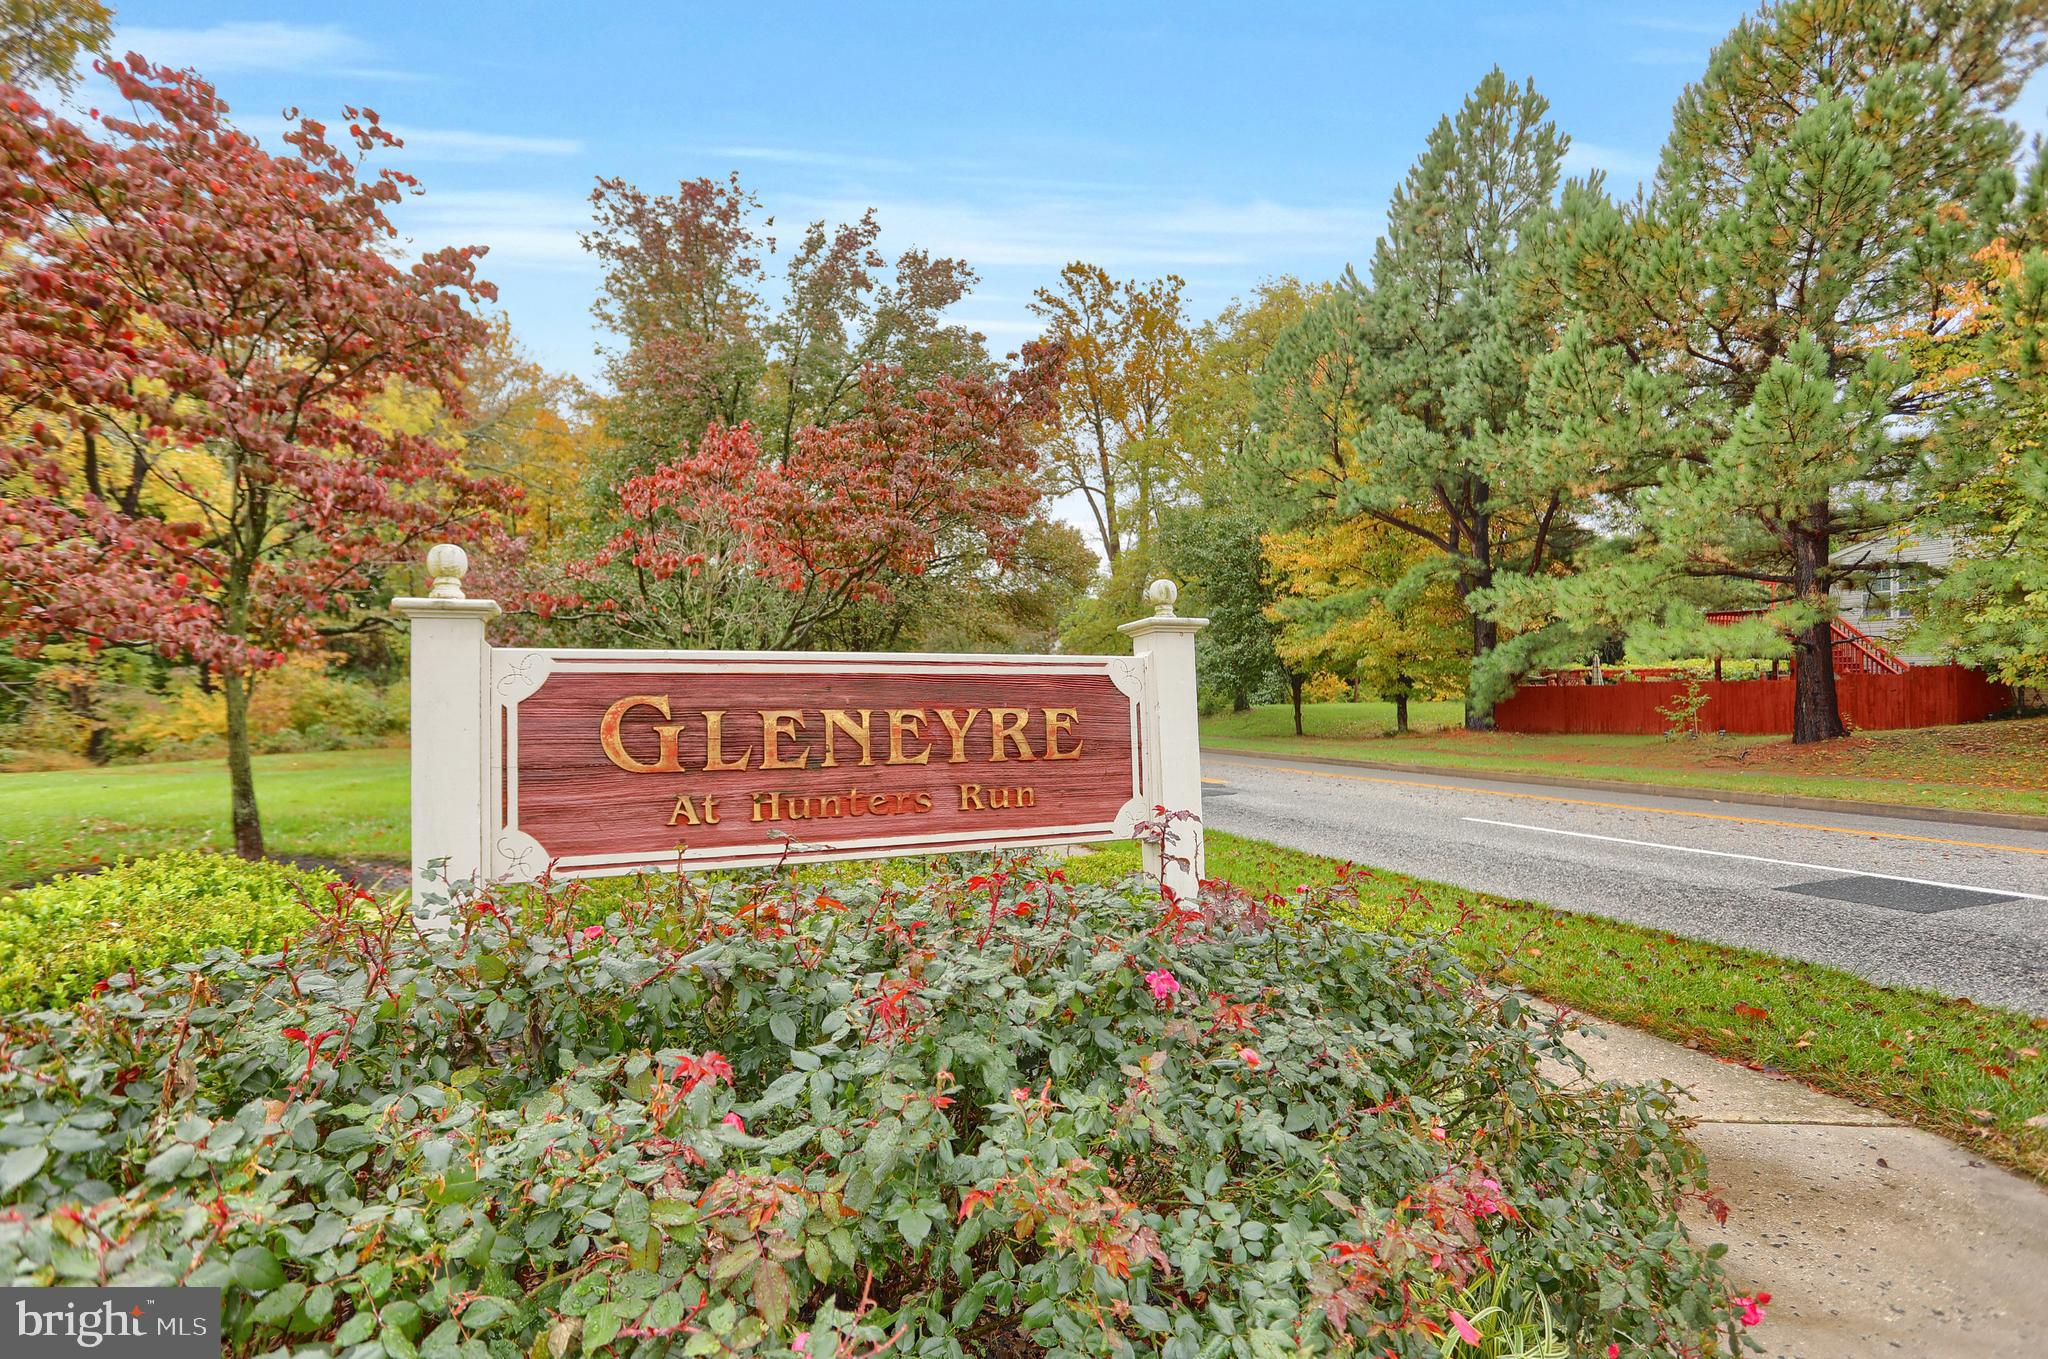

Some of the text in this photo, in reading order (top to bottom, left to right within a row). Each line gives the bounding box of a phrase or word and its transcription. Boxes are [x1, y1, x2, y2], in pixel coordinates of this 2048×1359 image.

[600, 693, 1084, 774] GLENEYRE
[666, 783, 1037, 826] At Hunters Run
